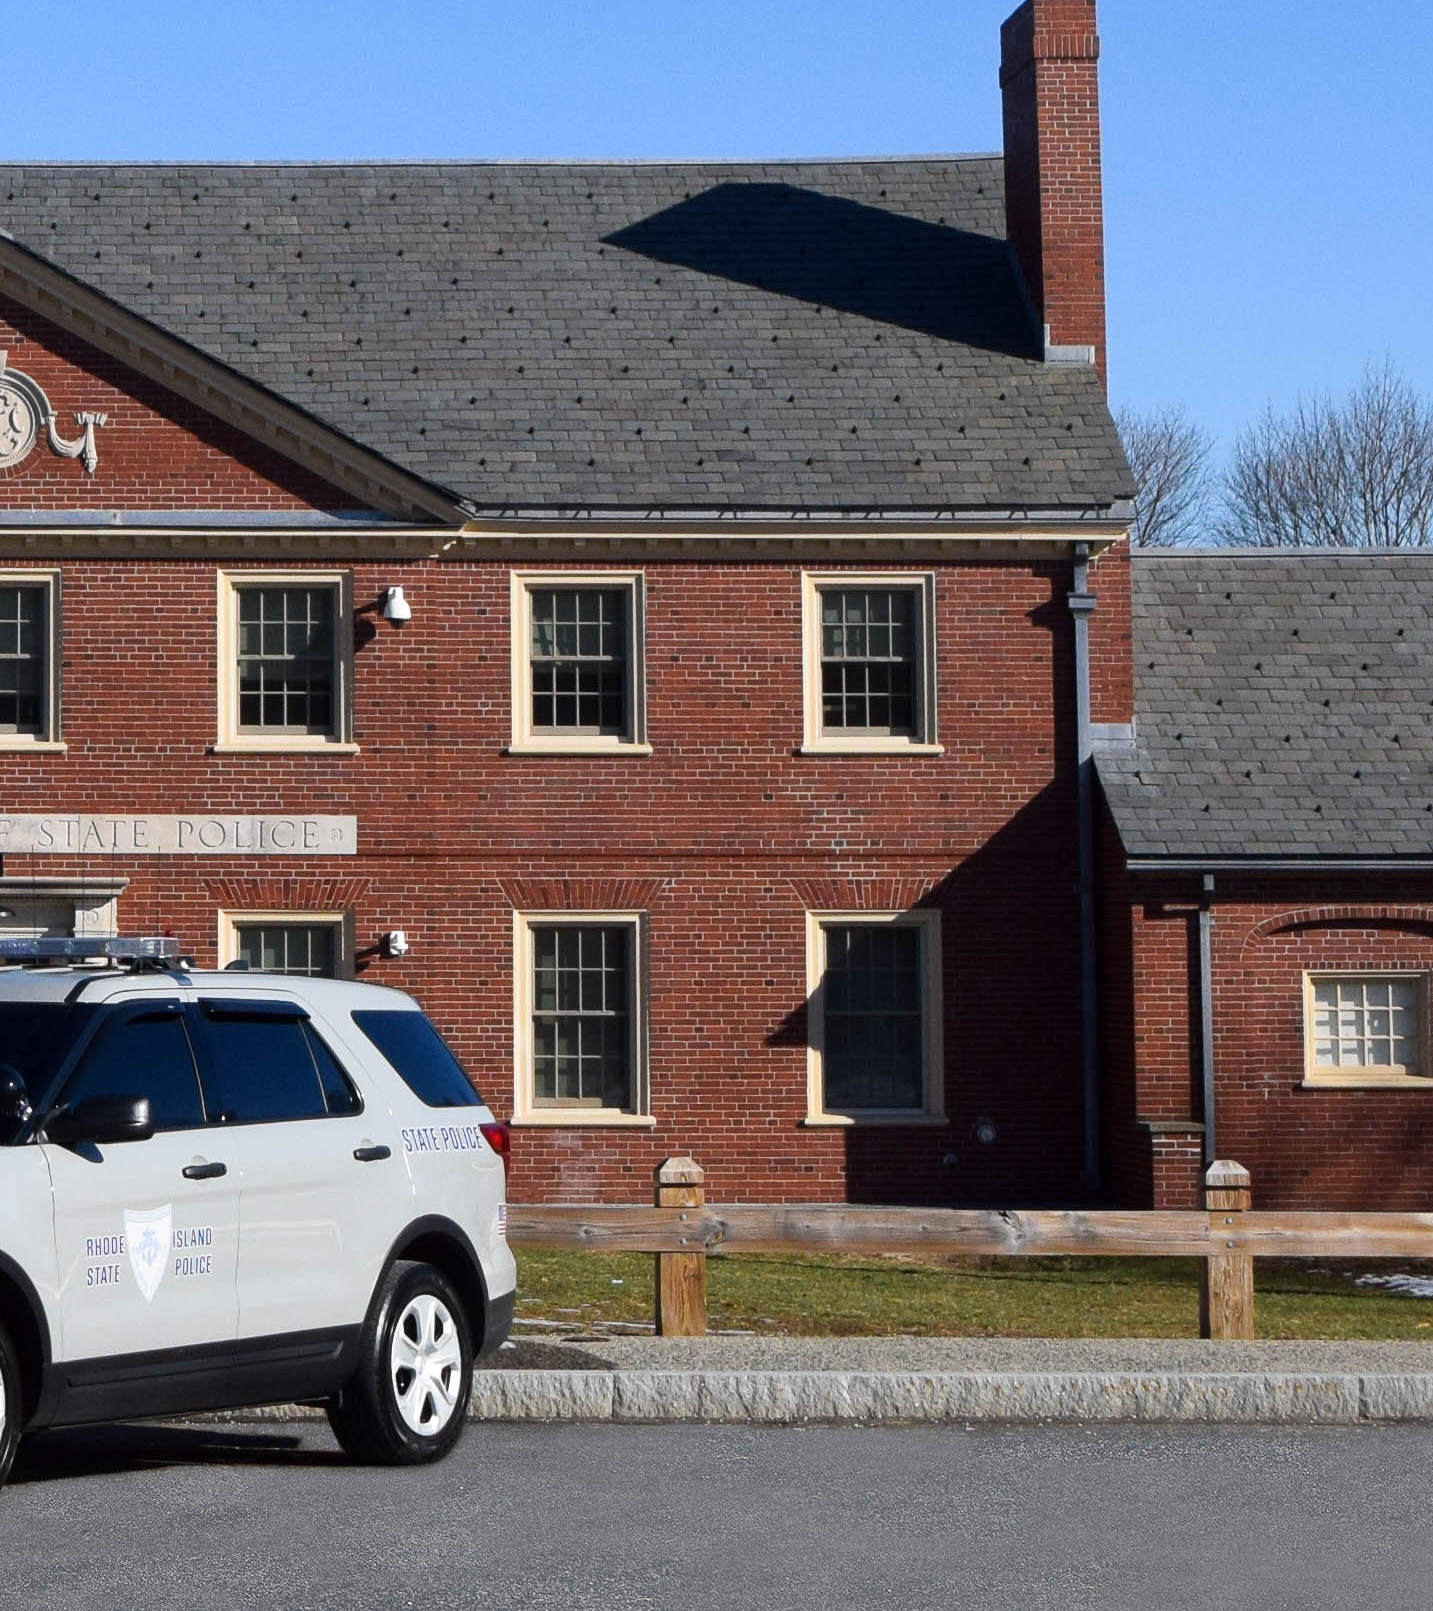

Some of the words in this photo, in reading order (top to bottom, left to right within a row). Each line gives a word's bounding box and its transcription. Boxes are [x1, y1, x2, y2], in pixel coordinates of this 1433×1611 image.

[36, 819, 149, 849] STATE
[176, 820, 320, 849] POLICE
[401, 1127, 440, 1152] STATE
[440, 1126, 483, 1150] POLICE
[86, 1235, 126, 1256] RHODE
[172, 1228, 213, 1248] ISLAND
[87, 1265, 121, 1286] STATE
[175, 1256, 212, 1276] POLICE
